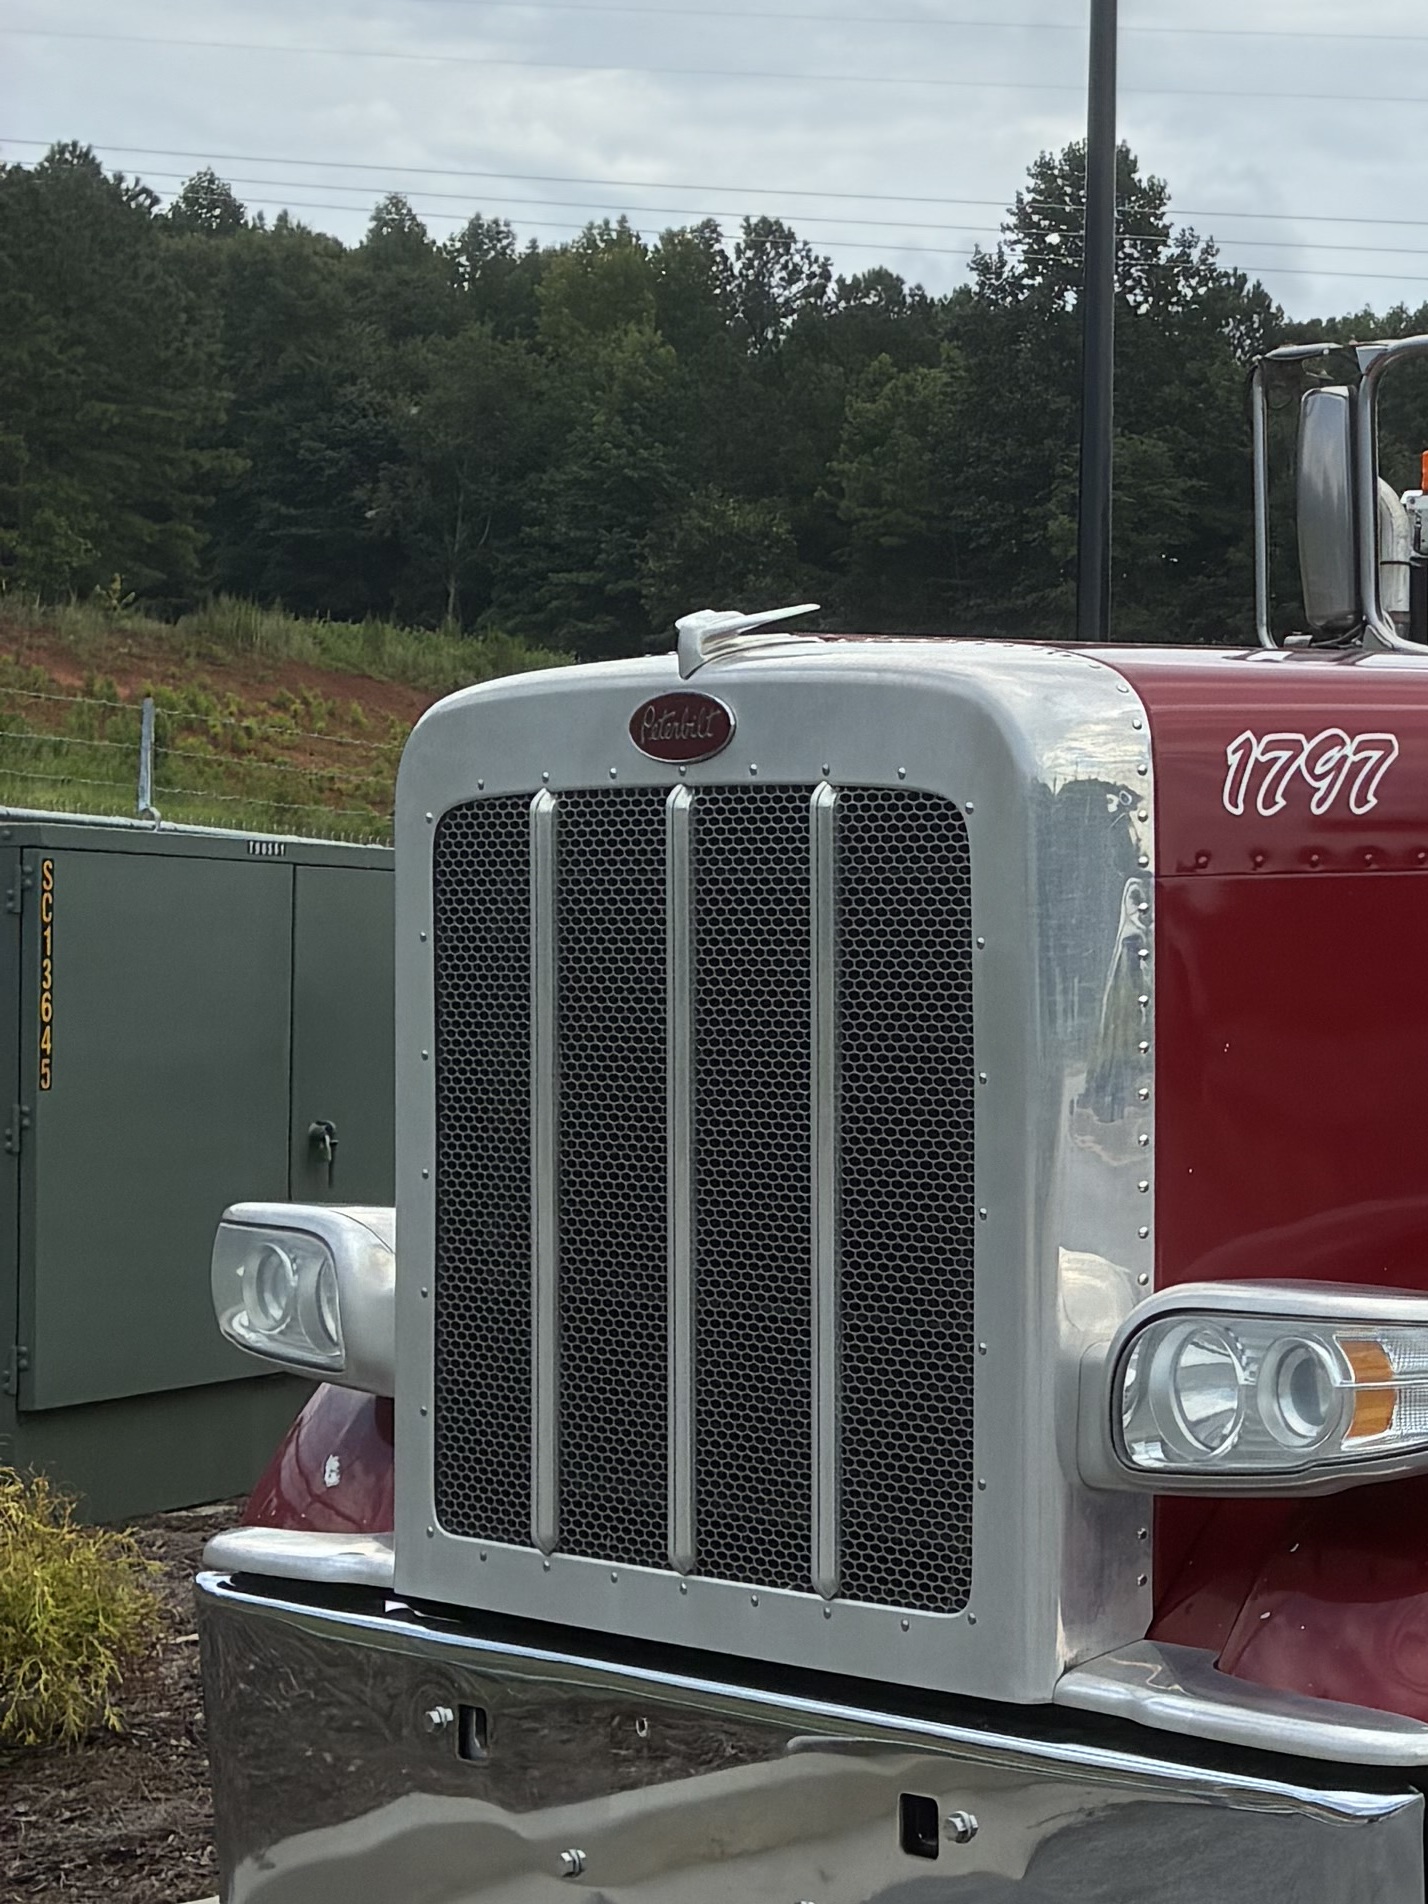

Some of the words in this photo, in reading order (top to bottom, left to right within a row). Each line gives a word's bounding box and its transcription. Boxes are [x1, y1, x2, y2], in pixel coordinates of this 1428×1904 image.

[640, 704, 722, 746] Peterbilt
[1222, 727, 1399, 817] 1797
[40, 859, 54, 1090] SC13645
